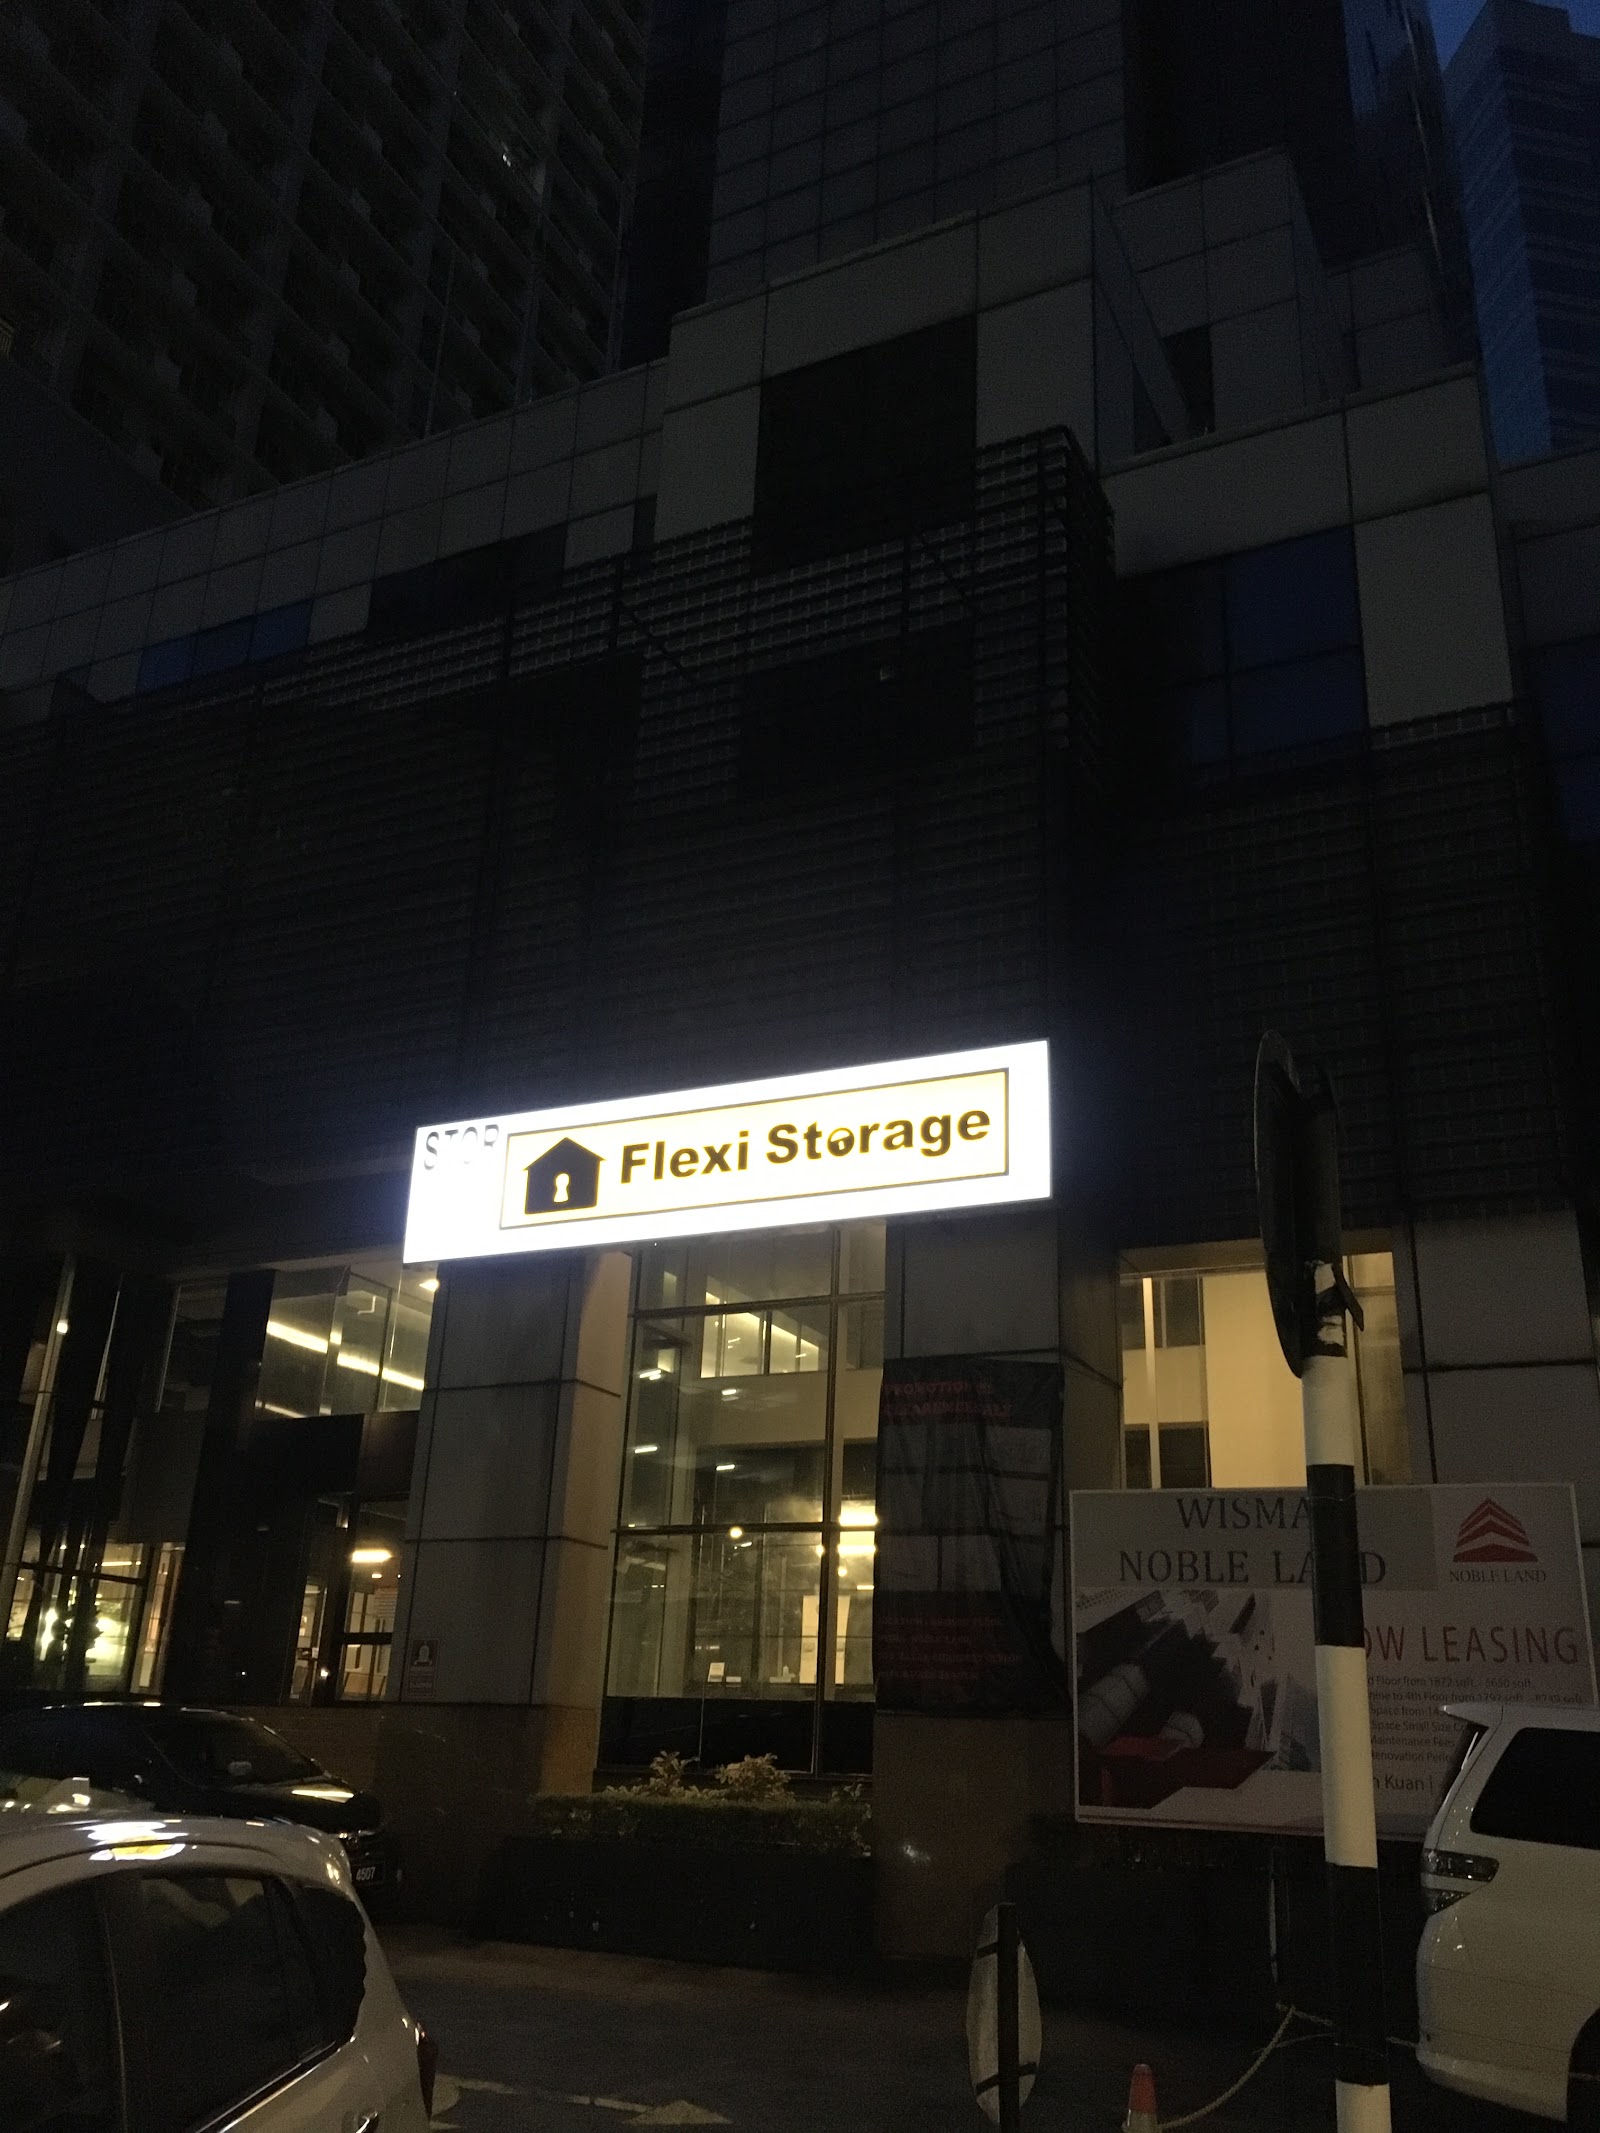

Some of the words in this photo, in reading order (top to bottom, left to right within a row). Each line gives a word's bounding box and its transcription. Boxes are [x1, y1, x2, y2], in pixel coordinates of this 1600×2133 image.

[621, 1130, 749, 1184] Flexi
[766, 1109, 991, 1165] Storage
[1119, 1549, 1250, 1584] NOBLE
[1449, 1569, 1499, 1583] NOBLE
[1503, 1569, 1547, 1583] LAND
[1421, 1626, 1579, 1665] LEASING
[1384, 1774, 1425, 1791] Kuan
